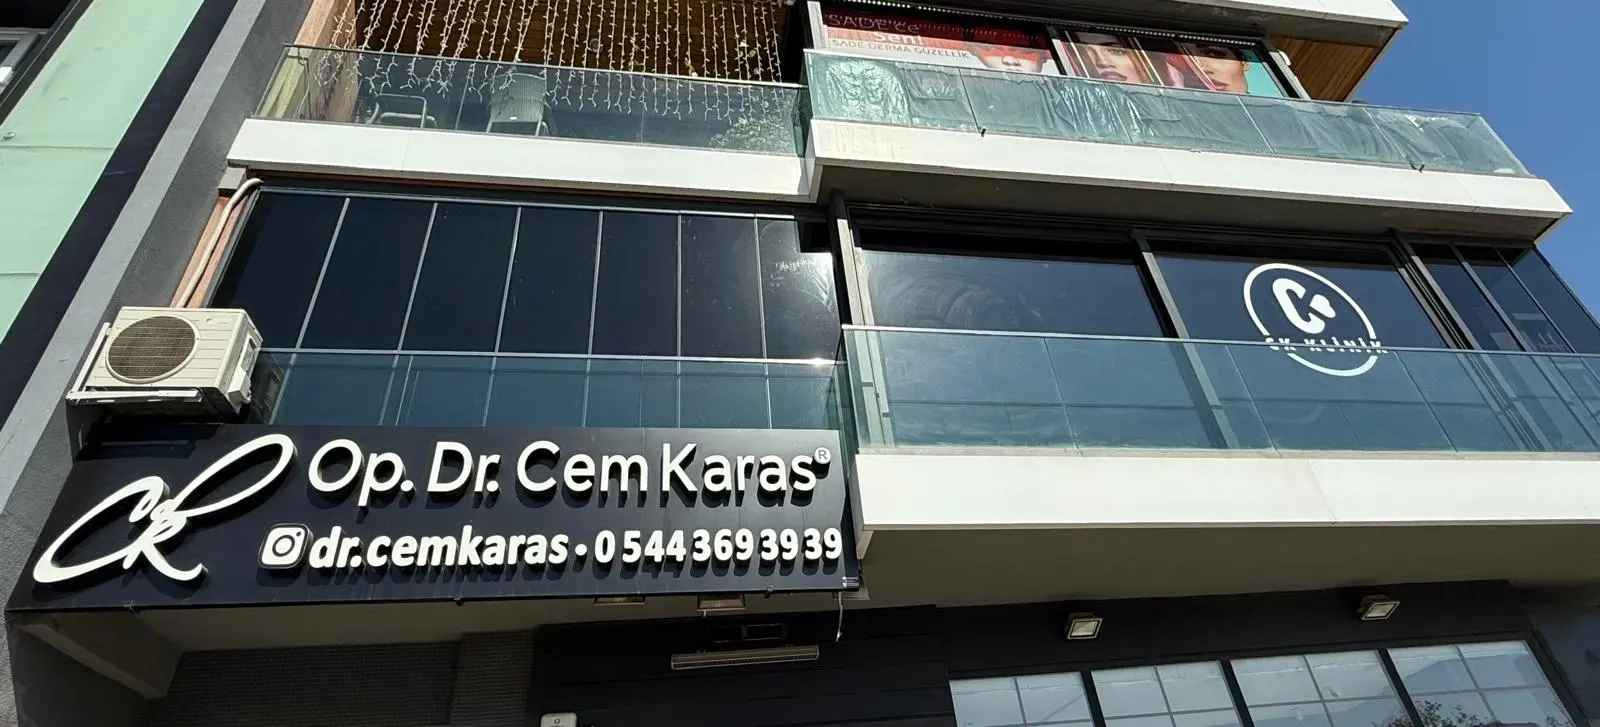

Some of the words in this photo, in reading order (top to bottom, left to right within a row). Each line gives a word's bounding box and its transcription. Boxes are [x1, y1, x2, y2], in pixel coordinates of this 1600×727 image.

[833, 39, 864, 48] SADE
[868, 43, 911, 53] DERMA
[309, 439, 414, 506] Op.
[428, 442, 499, 492] Dr.
[517, 441, 648, 492] Cem
[309, 526, 568, 568] dr.cemkaras
[623, 530, 686, 562] 544
[693, 528, 754, 561] 369
[761, 528, 798, 560] 39
[804, 528, 842, 559] 39
